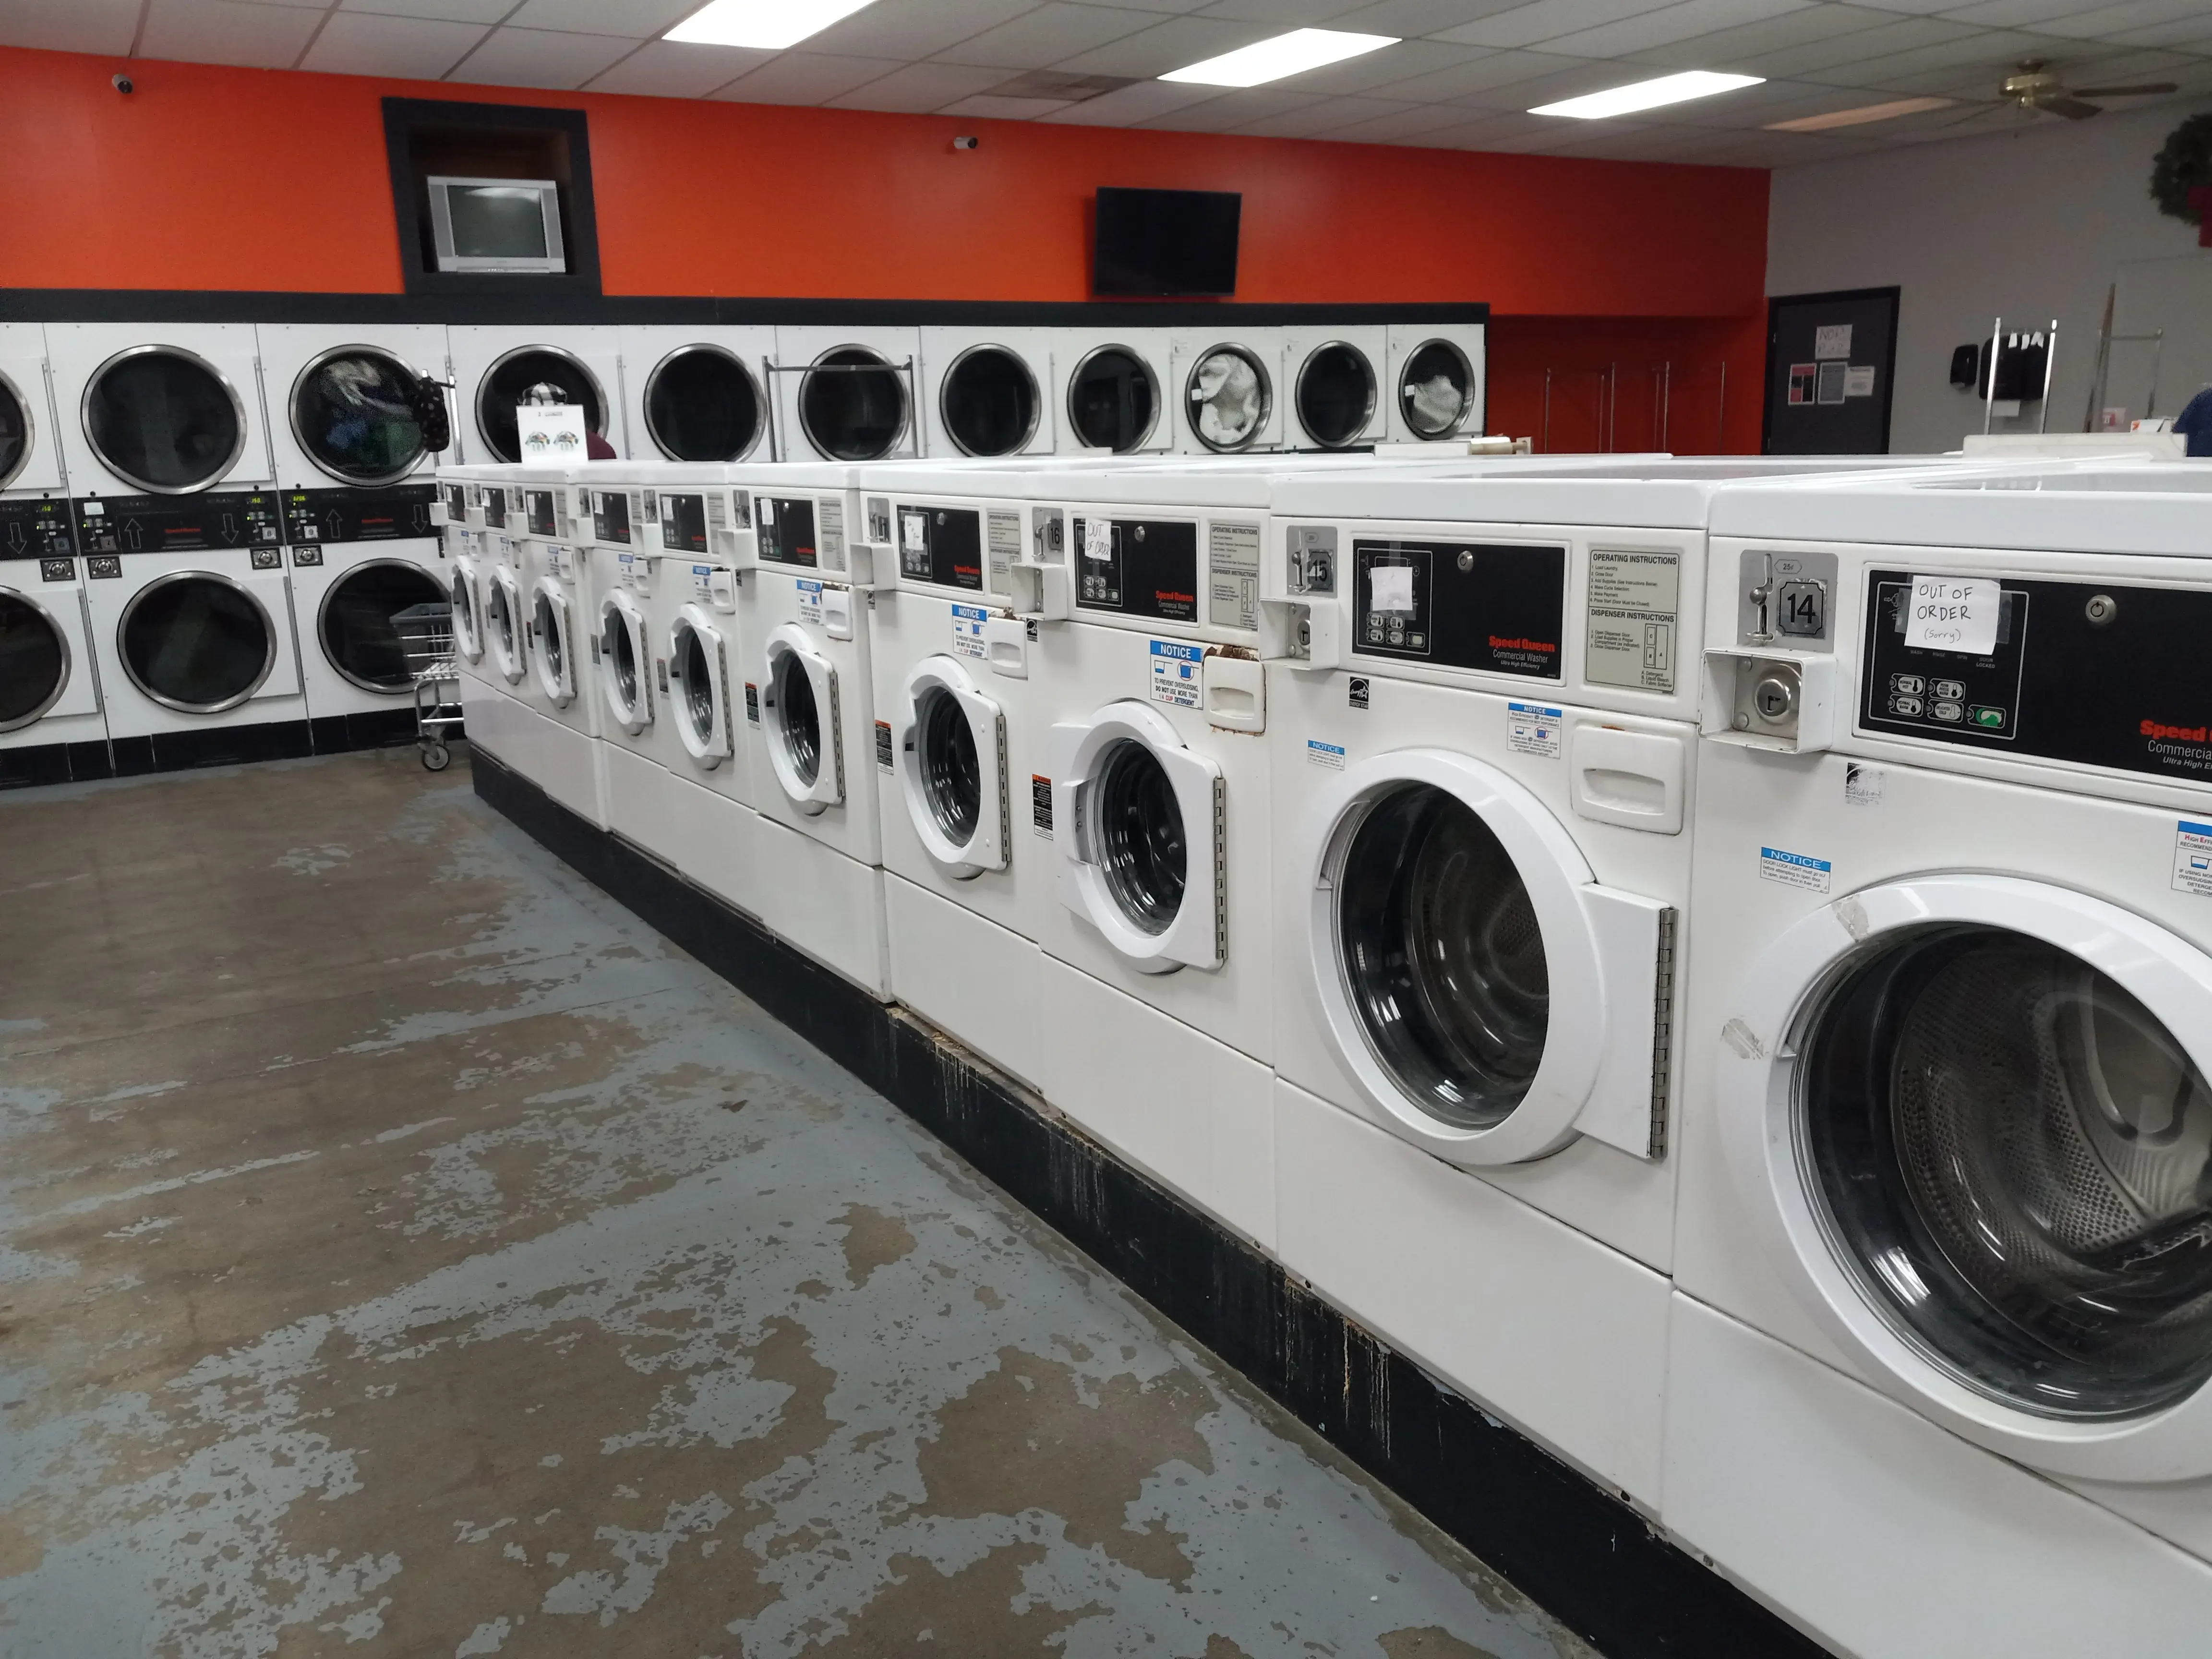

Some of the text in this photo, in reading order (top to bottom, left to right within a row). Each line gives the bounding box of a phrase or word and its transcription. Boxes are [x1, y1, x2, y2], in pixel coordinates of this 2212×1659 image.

[1050, 527, 1060, 545] 16
[1087, 522, 1104, 537] OUT
[1593, 553, 1677, 565] OPERATING INSTRUCTIONS
[1312, 559, 1327, 581] 15
[1919, 584, 1973, 601] OUT OF
[958, 607, 980, 619] NOTICE
[1591, 609, 1674, 623] DISPENSER INSTRUCTIONS
[1787, 593, 1816, 624] 14
[1917, 605, 1972, 621] ORDER
[1924, 627, 1961, 644] (Sorry)
[1160, 643, 1191, 659] NOTICE
[1489, 635, 1555, 652] Speed Queen
[1492, 649, 1549, 663] Commercial Washer
[1159, 679, 1174, 687] PREVENT
[1178, 689, 1188, 697] MORE
[1174, 697, 1195, 707] DETERGENT
[1524, 706, 1546, 714] NOTICE
[2140, 719, 2206, 743] Speed
[1313, 742, 1340, 754] NOTICE
[2163, 756, 2203, 769] Ultra High
[1771, 851, 1822, 869] NOTICE
